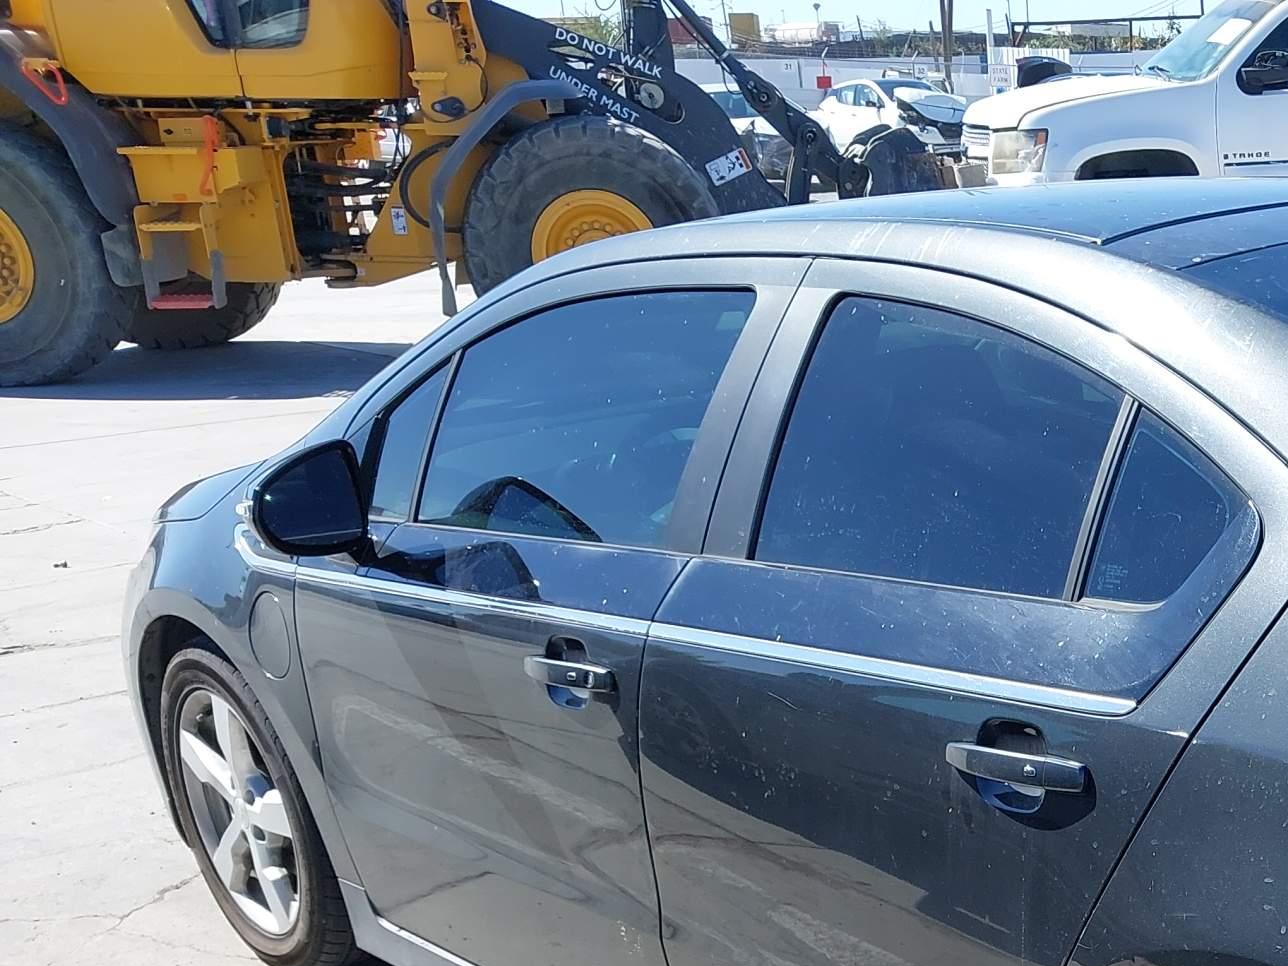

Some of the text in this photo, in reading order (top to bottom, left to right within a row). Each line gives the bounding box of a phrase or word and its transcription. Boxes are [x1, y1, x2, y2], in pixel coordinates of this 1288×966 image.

[555, 27, 662, 78] DO NOT WALK
[992, 67, 1009, 75] STATE
[549, 65, 640, 123] UNDER MAST
[1232, 151, 1270, 159] TAHOE
